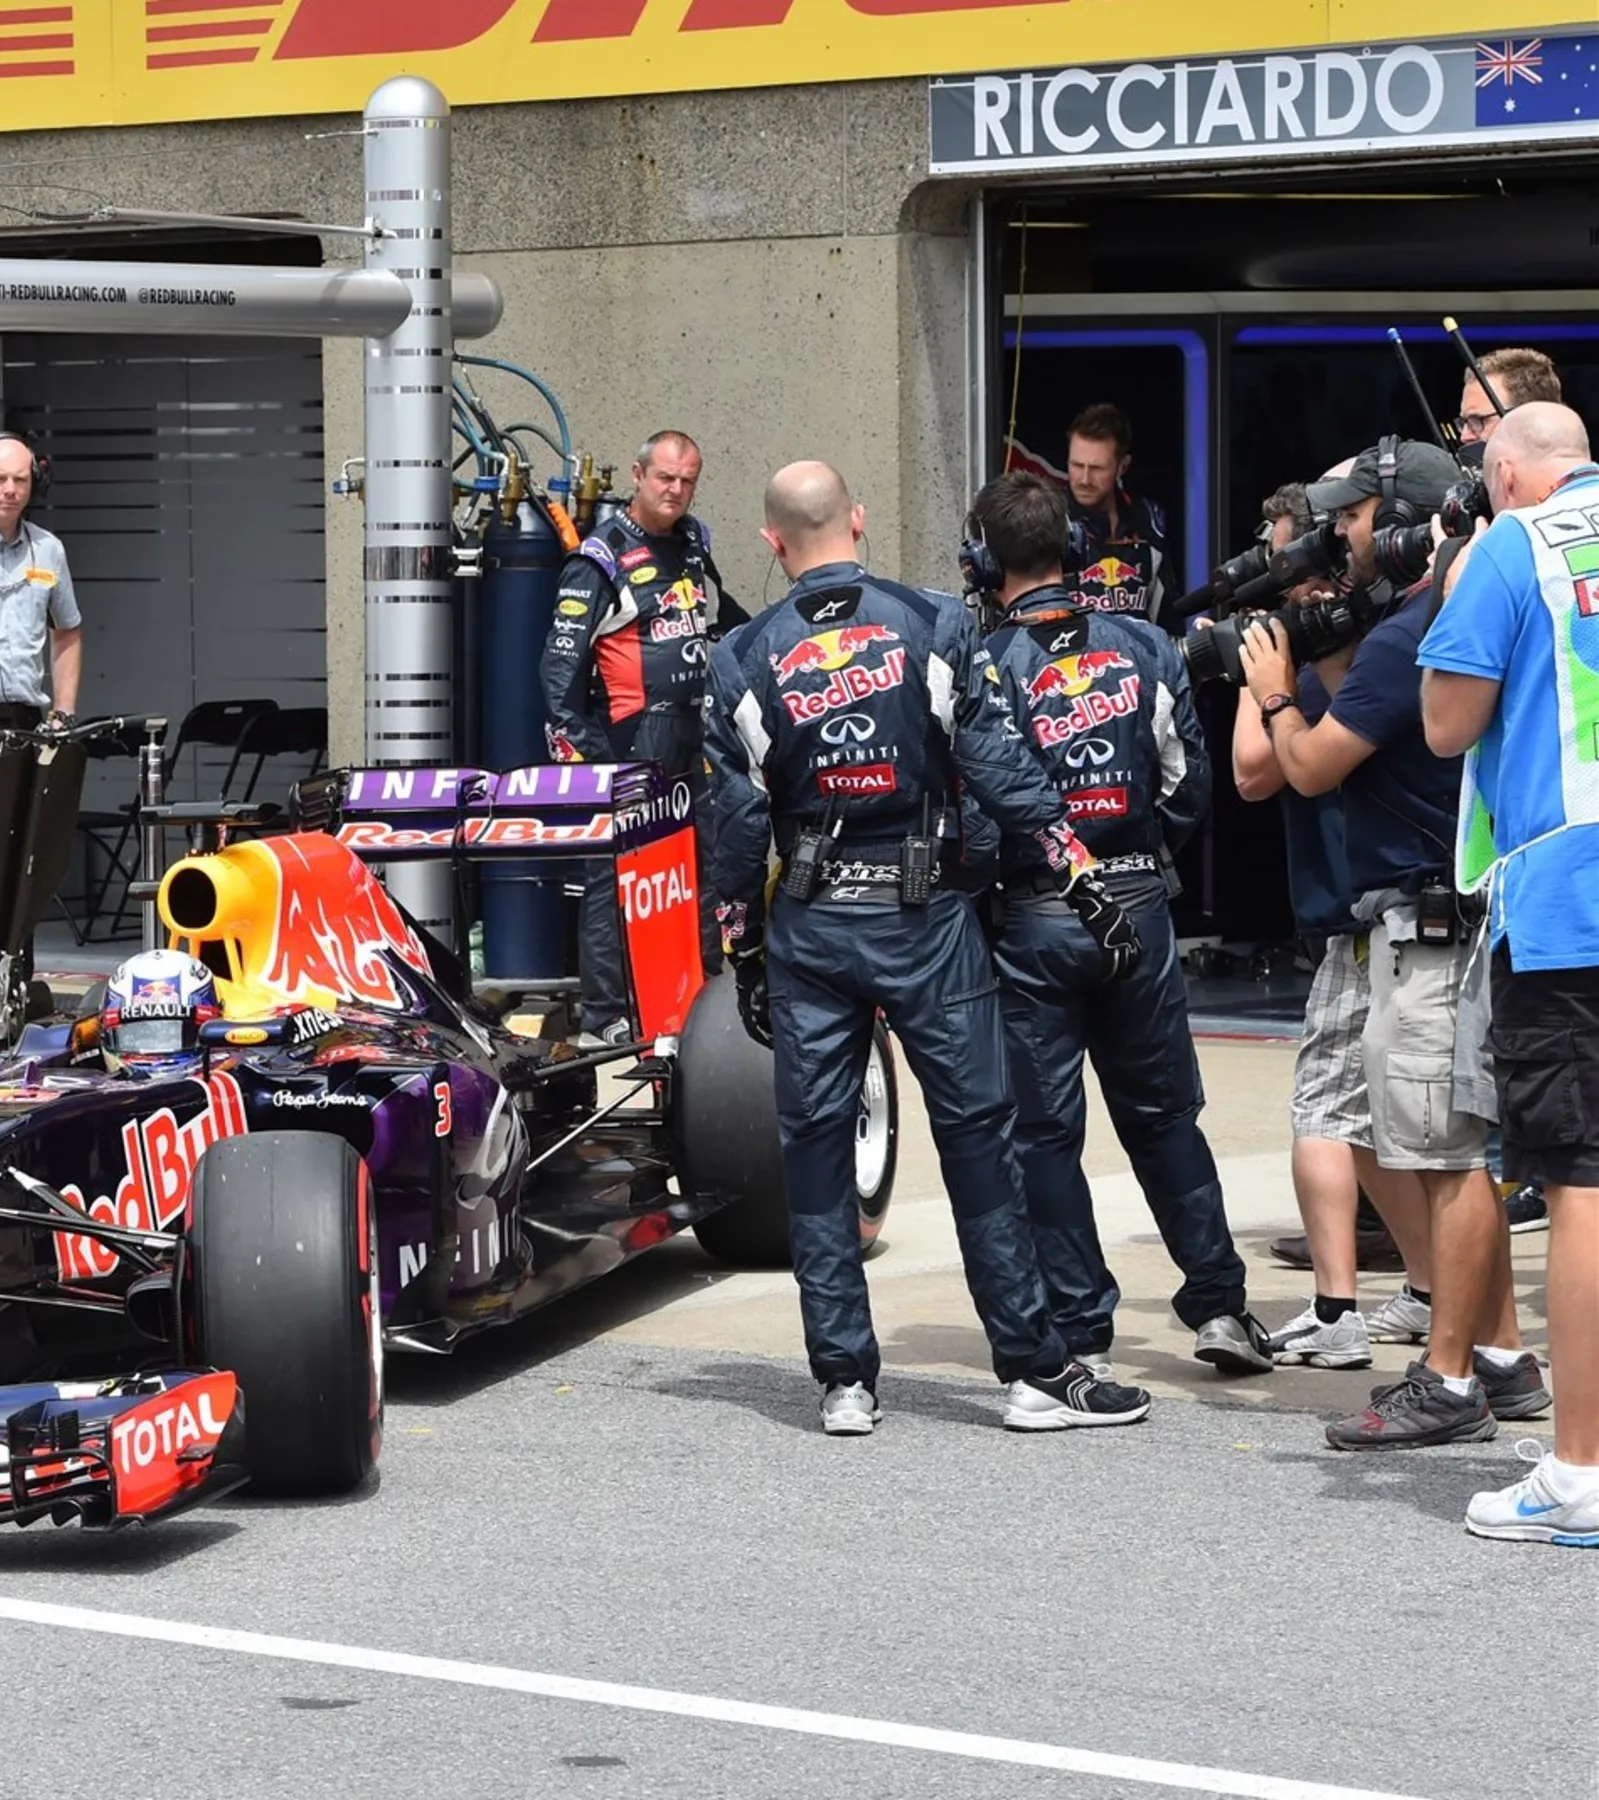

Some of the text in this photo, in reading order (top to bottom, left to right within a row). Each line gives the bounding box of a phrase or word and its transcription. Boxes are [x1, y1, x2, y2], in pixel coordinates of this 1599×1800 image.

[971, 44, 1445, 157] RICCIARDO
[138, 288, 236, 306] @REDBULLRACING
[1115, 586, 1148, 610] Bull
[651, 611, 695, 642] Red
[782, 647, 905, 726] Red Bull
[1032, 698, 1093, 749] Red
[1086, 674, 1140, 726] Bull
[809, 746, 898, 769] INFINITI
[348, 764, 617, 801] INFNIT
[822, 774, 891, 790] TOTAL
[1052, 770, 1132, 791] INFINITI
[335, 814, 613, 846] Red Bul
[619, 862, 693, 923] TOTAL
[120, 1003, 193, 1020] RENAULT
[273, 1090, 367, 1108] Pepe Jeans
[434, 1081, 451, 1137] 3
[53, 1069, 250, 1285] Red Bull
[111, 1393, 227, 1474] TOTAL
